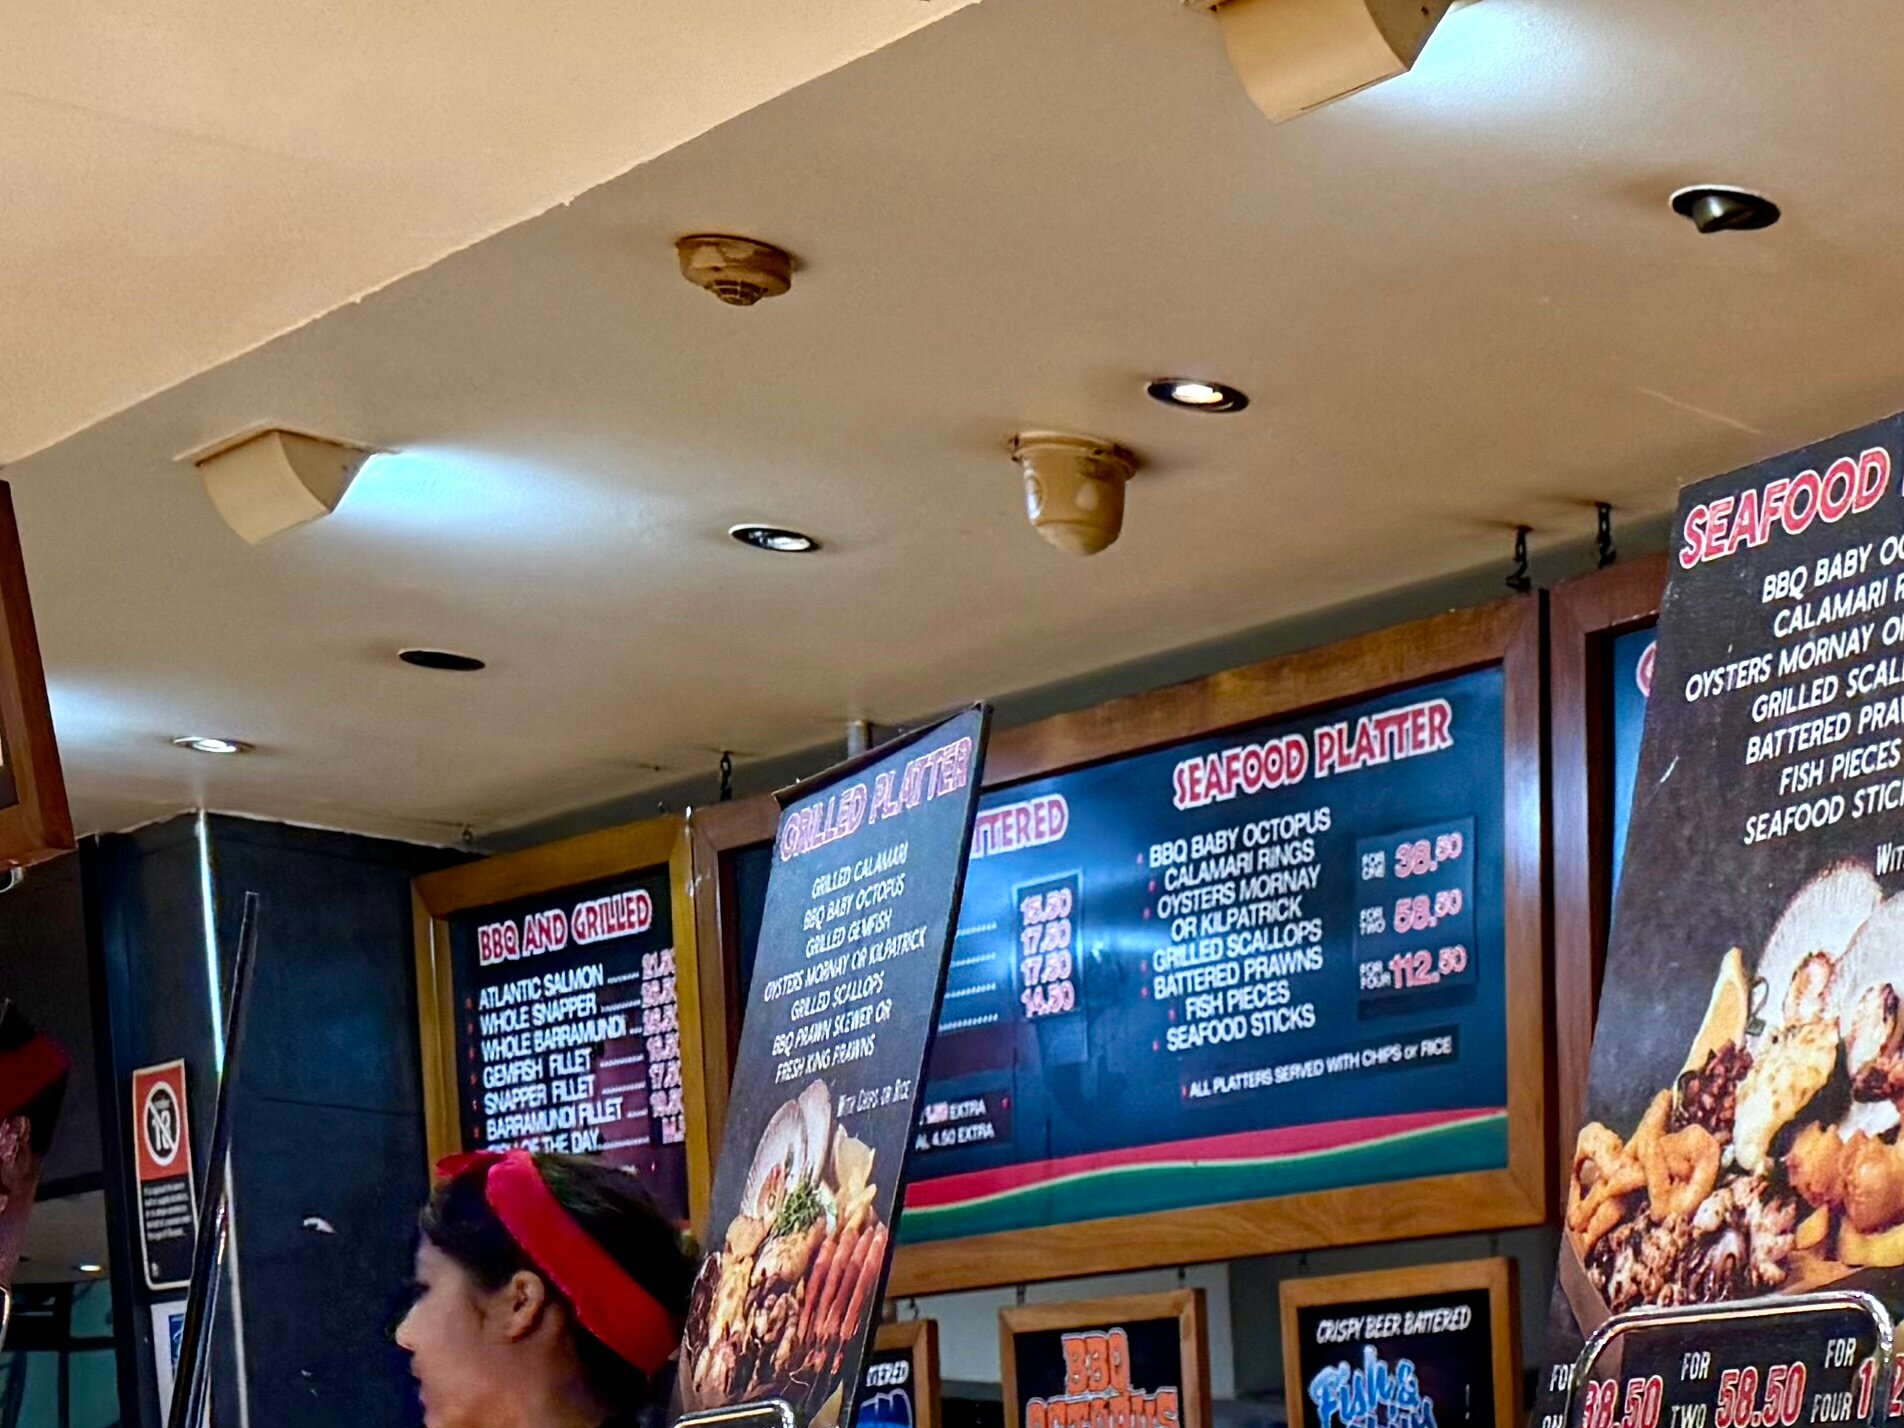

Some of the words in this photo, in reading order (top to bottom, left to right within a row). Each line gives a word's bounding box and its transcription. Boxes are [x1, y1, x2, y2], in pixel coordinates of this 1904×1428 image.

[1679, 446, 1890, 569] SEAFOOD
[1762, 565, 1807, 605] BBQ
[1814, 550, 1872, 593] BABY
[1773, 583, 1889, 638] CALAMARI
[1685, 652, 1773, 703] OYSTERS
[1779, 629, 1875, 683] MORNAY
[1173, 733, 1309, 809] SEAFOOD
[1314, 699, 1454, 779] PLATTER
[1779, 758, 1824, 795] FISH
[1831, 738, 1902, 783] PIECES
[779, 783, 867, 862] GRILLED
[869, 736, 973, 824] PLATTER
[1744, 790, 1846, 845] SEAFOOD
[1150, 841, 1188, 868] BBQ
[1190, 825, 1238, 860] BABY
[1243, 807, 1331, 846] OCTOPUS
[478, 921, 520, 966] BBQ
[522, 909, 568, 957] AND
[571, 890, 652, 945] GRILLED
[803, 904, 825, 931] BBQ
[826, 895, 853, 922] BABY
[856, 873, 906, 909] OCTOPUS
[479, 979, 542, 1010] ATLANTIC
[544, 964, 604, 997] SALMON
[480, 1007, 530, 1035] WHOLE
[532, 994, 598, 1026] SNAPPER
[1166, 1016, 1248, 1050] SEAFOOD
[1251, 1005, 1315, 1038] STICKS
[1061, 1327, 1129, 1395] BBQ
